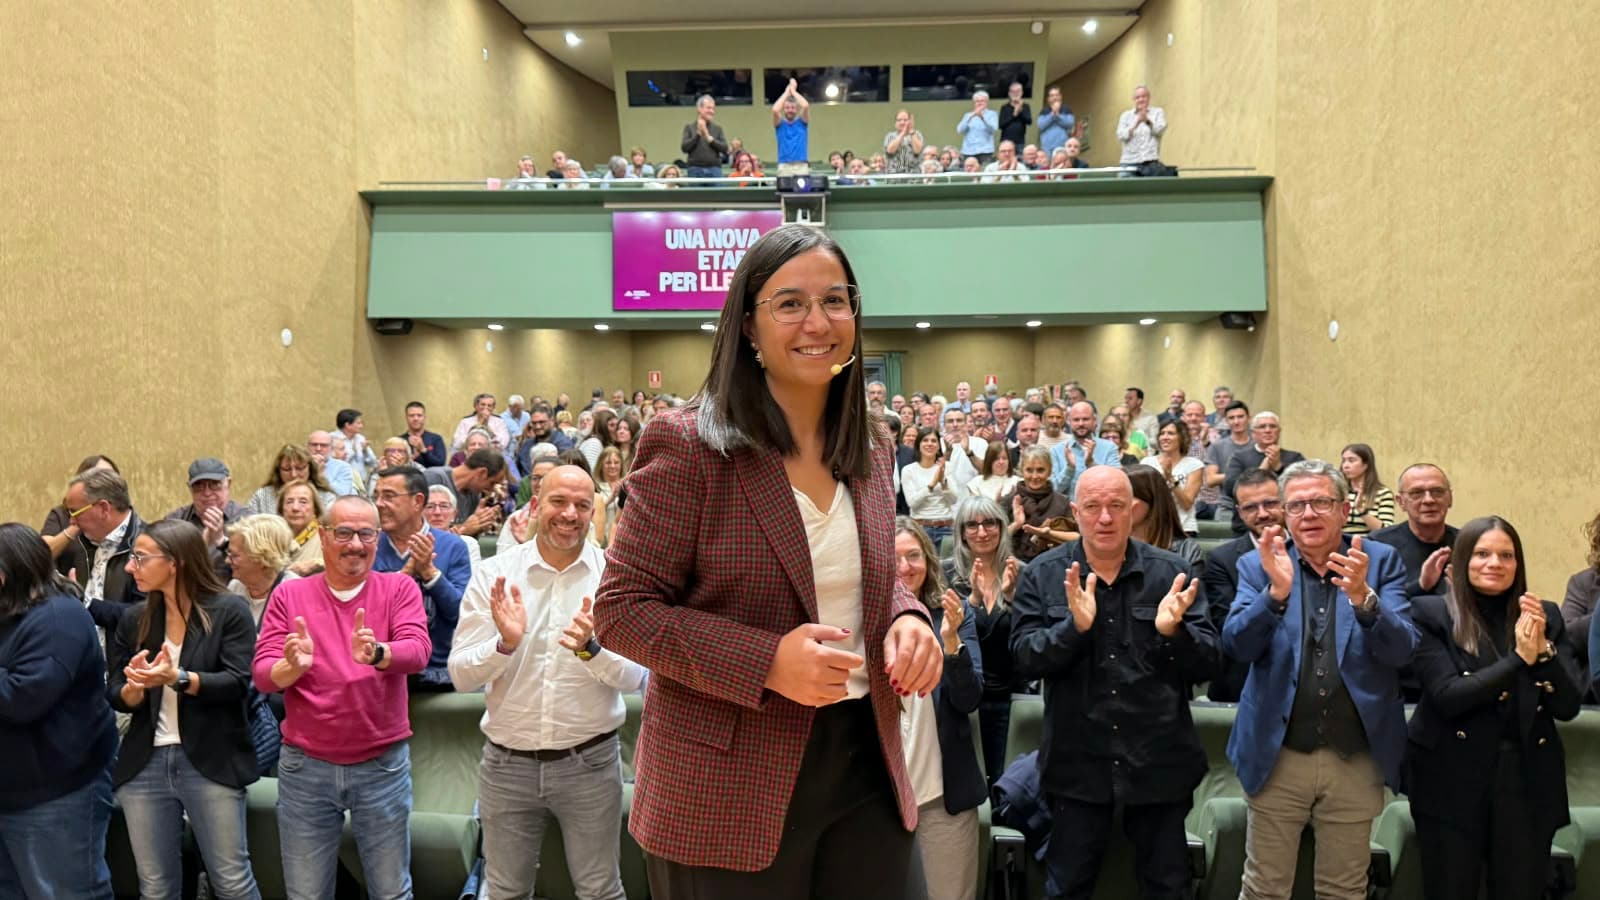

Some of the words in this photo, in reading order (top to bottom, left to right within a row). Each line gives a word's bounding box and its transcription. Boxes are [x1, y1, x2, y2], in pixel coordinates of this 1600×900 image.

[665, 228, 706, 250] UNA
[708, 228, 761, 249] NOVA
[659, 271, 698, 292] PER
[700, 271, 735, 292] LLE
